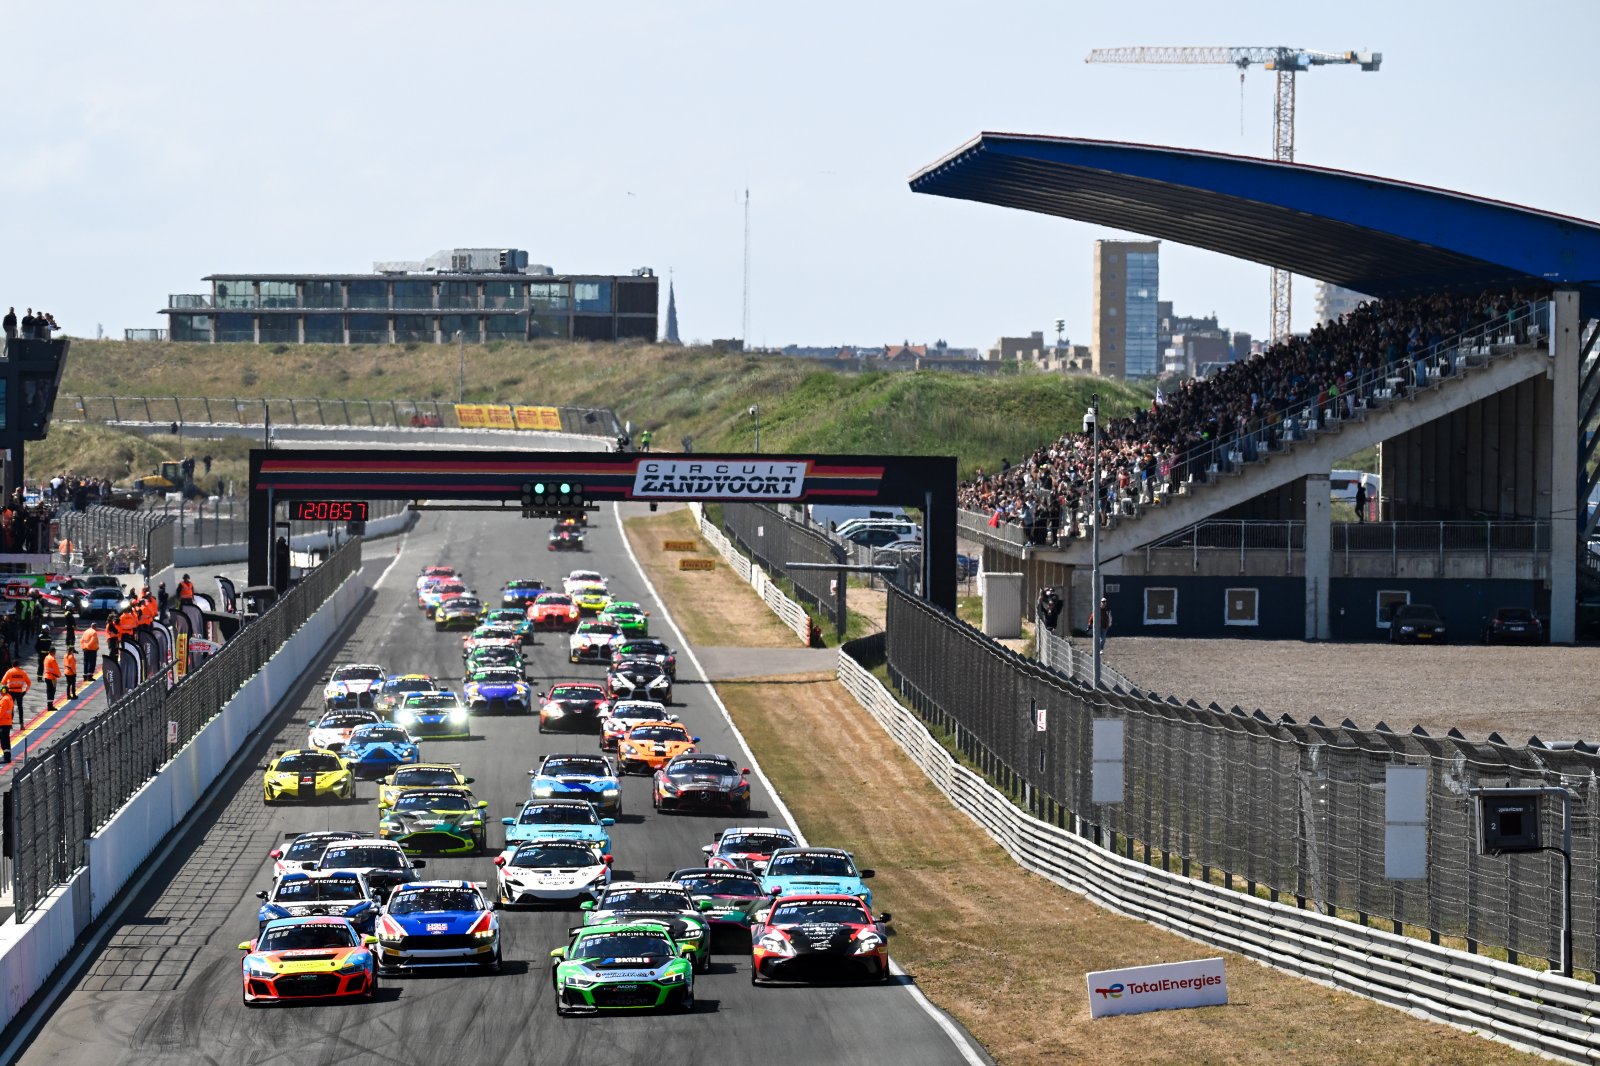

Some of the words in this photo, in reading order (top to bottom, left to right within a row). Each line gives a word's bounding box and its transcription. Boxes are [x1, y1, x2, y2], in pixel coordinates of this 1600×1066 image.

[645, 463, 798, 475] CIRCUIT
[641, 475, 797, 494] ZANDVOORT
[297, 502, 366, 520] 12:08:57
[1491, 822, 1496, 830] 2
[1126, 974, 1222, 994] TotalEnergies
